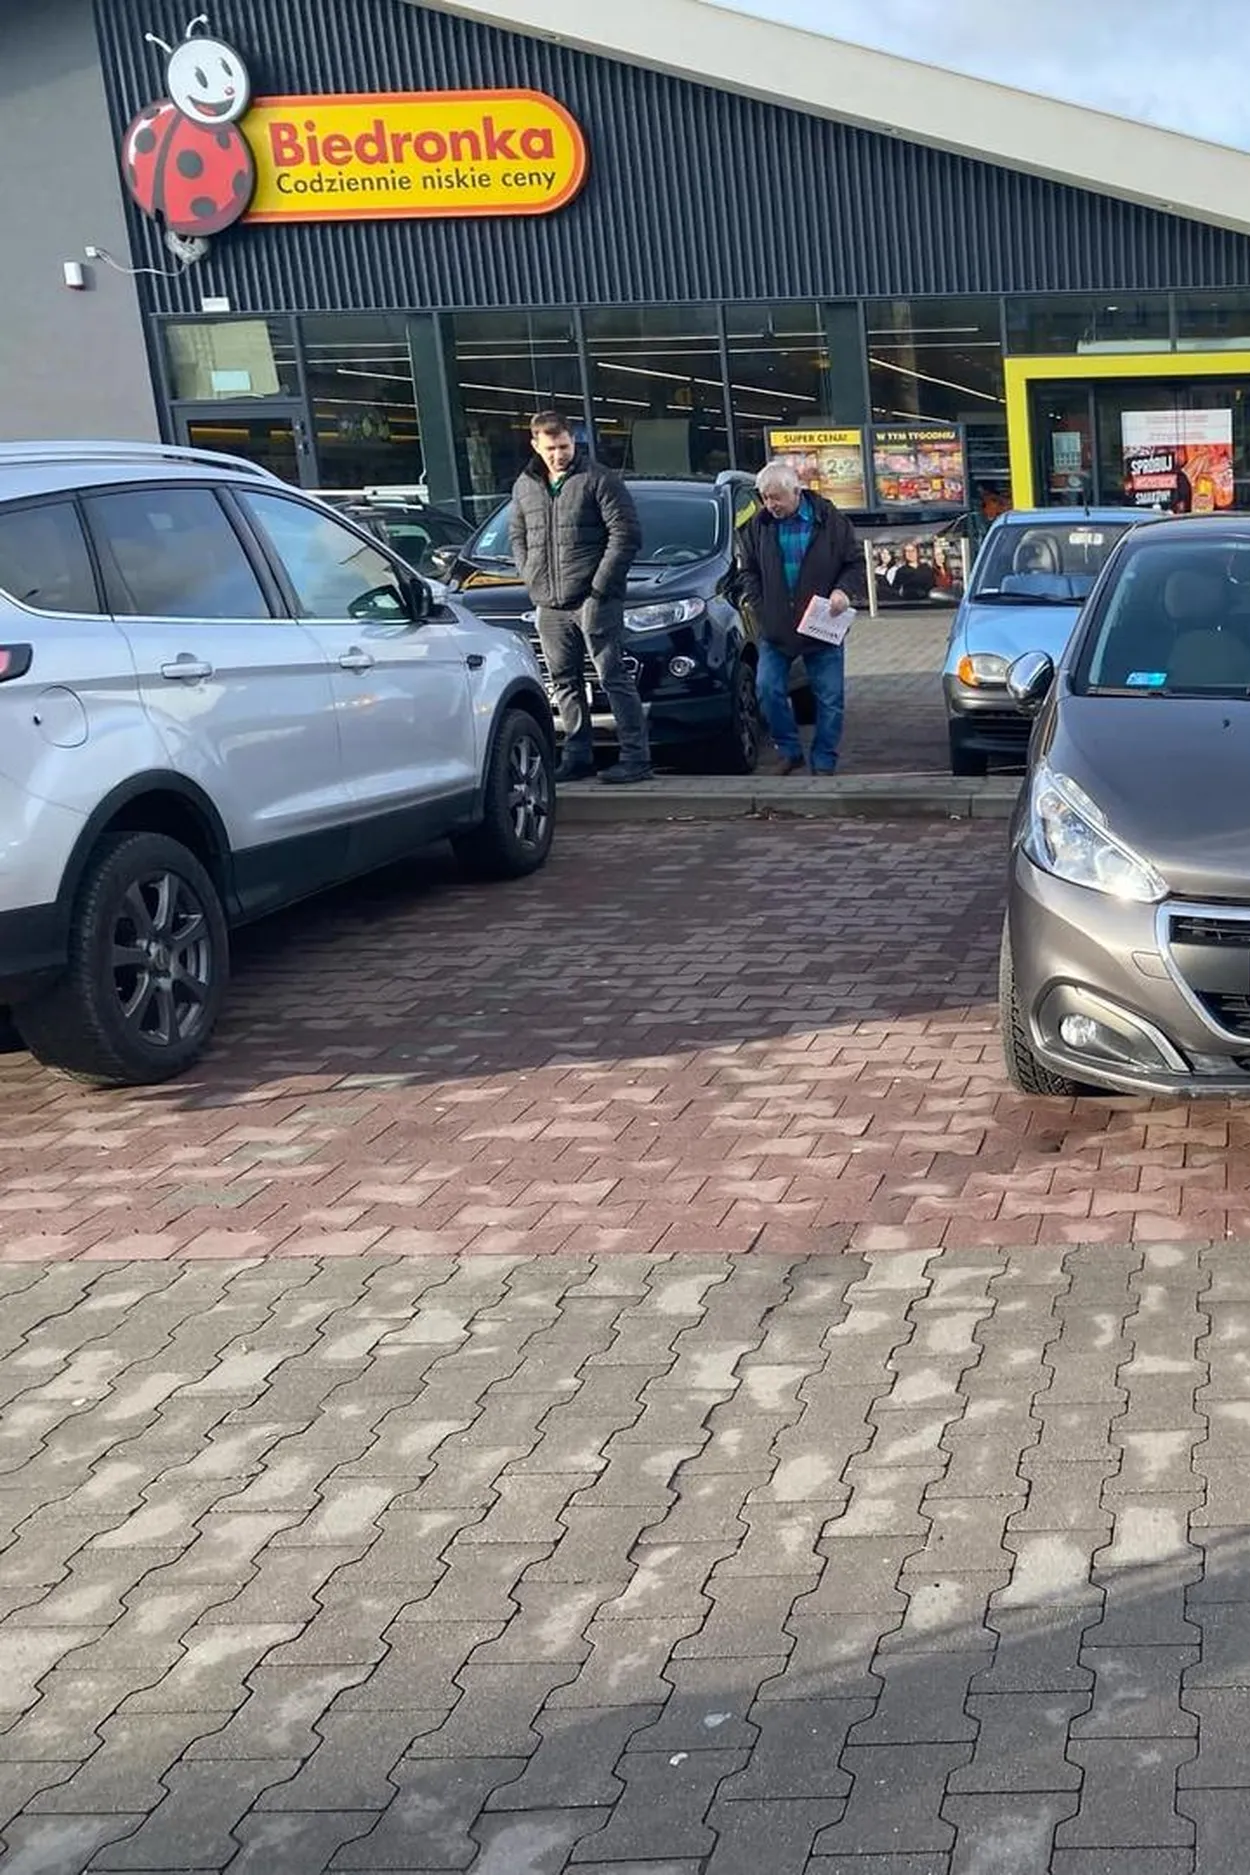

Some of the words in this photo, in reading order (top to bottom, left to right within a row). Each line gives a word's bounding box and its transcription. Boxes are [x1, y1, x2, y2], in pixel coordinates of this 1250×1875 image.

[268, 116, 555, 168] Biedronka
[276, 169, 412, 194] Codziennie
[422, 167, 491, 189] niskie
[501, 171, 556, 190] ceny
[783, 433, 816, 443] SUPER
[818, 433, 848, 442] CENA!
[888, 432, 907, 440] TYM
[908, 431, 955, 440] TYGODNIU
